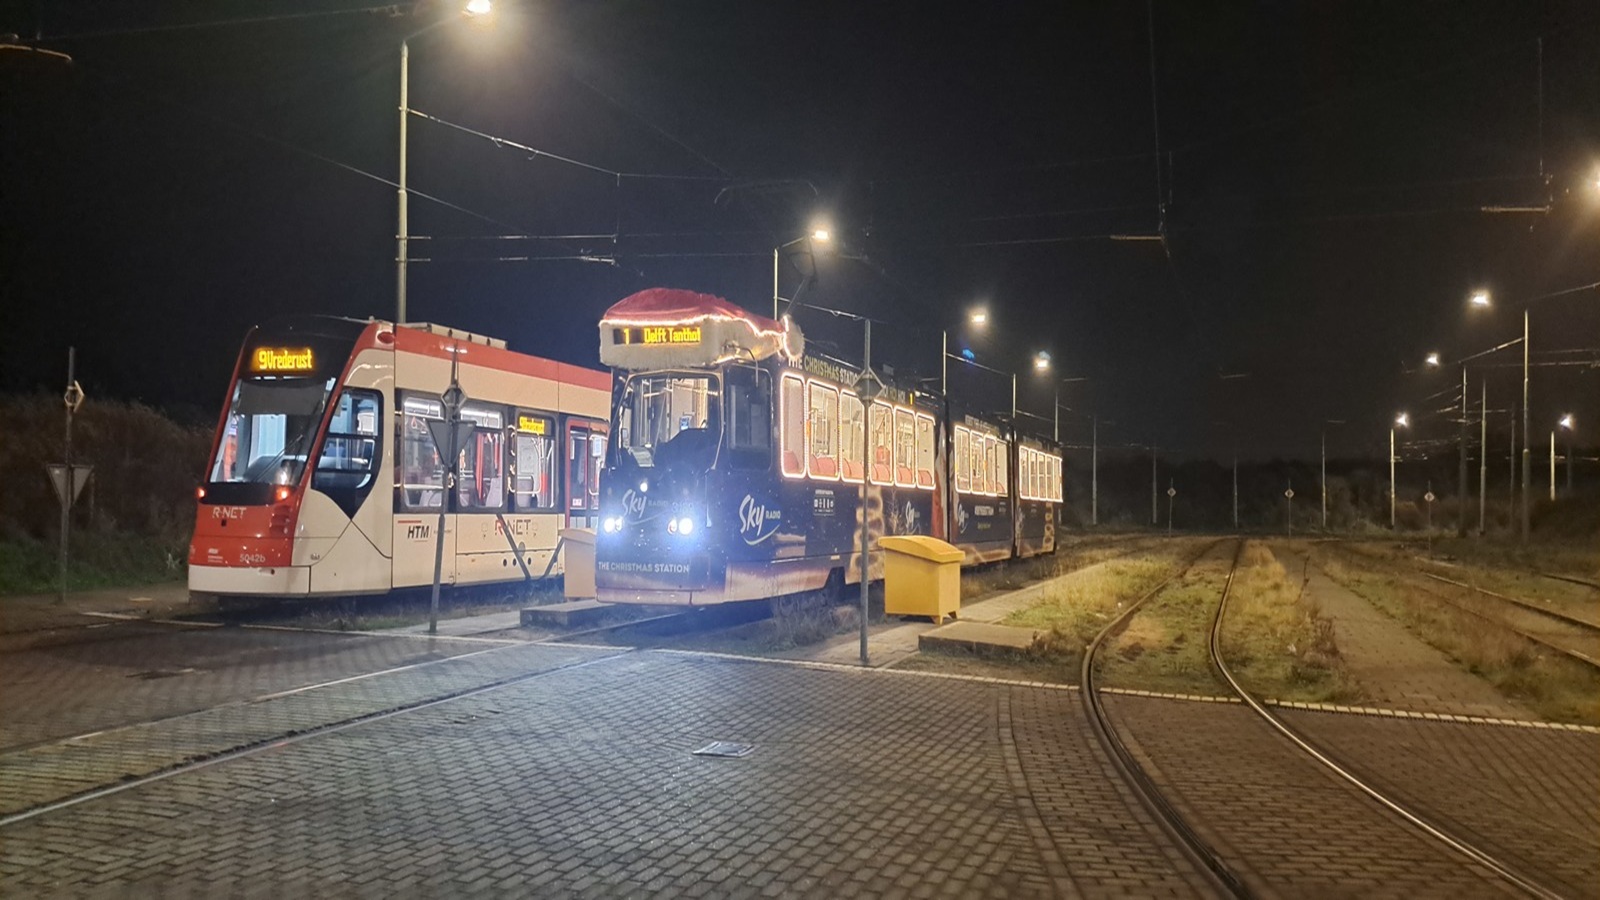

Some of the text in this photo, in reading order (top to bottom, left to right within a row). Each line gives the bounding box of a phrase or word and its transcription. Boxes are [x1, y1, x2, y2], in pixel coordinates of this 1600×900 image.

[623, 328, 630, 344] 1
[644, 328, 666, 343] Delft
[258, 349, 313, 369] 9 Vrederust
[803, 356, 840, 382] CHRISTMAS
[621, 489, 647, 518] Sky
[738, 494, 781, 536] Sky RADIO
[407, 525, 430, 539] HTM
[494, 519, 532, 536] RNET
[598, 561, 690, 574] THE CHRISTMAS STATION
